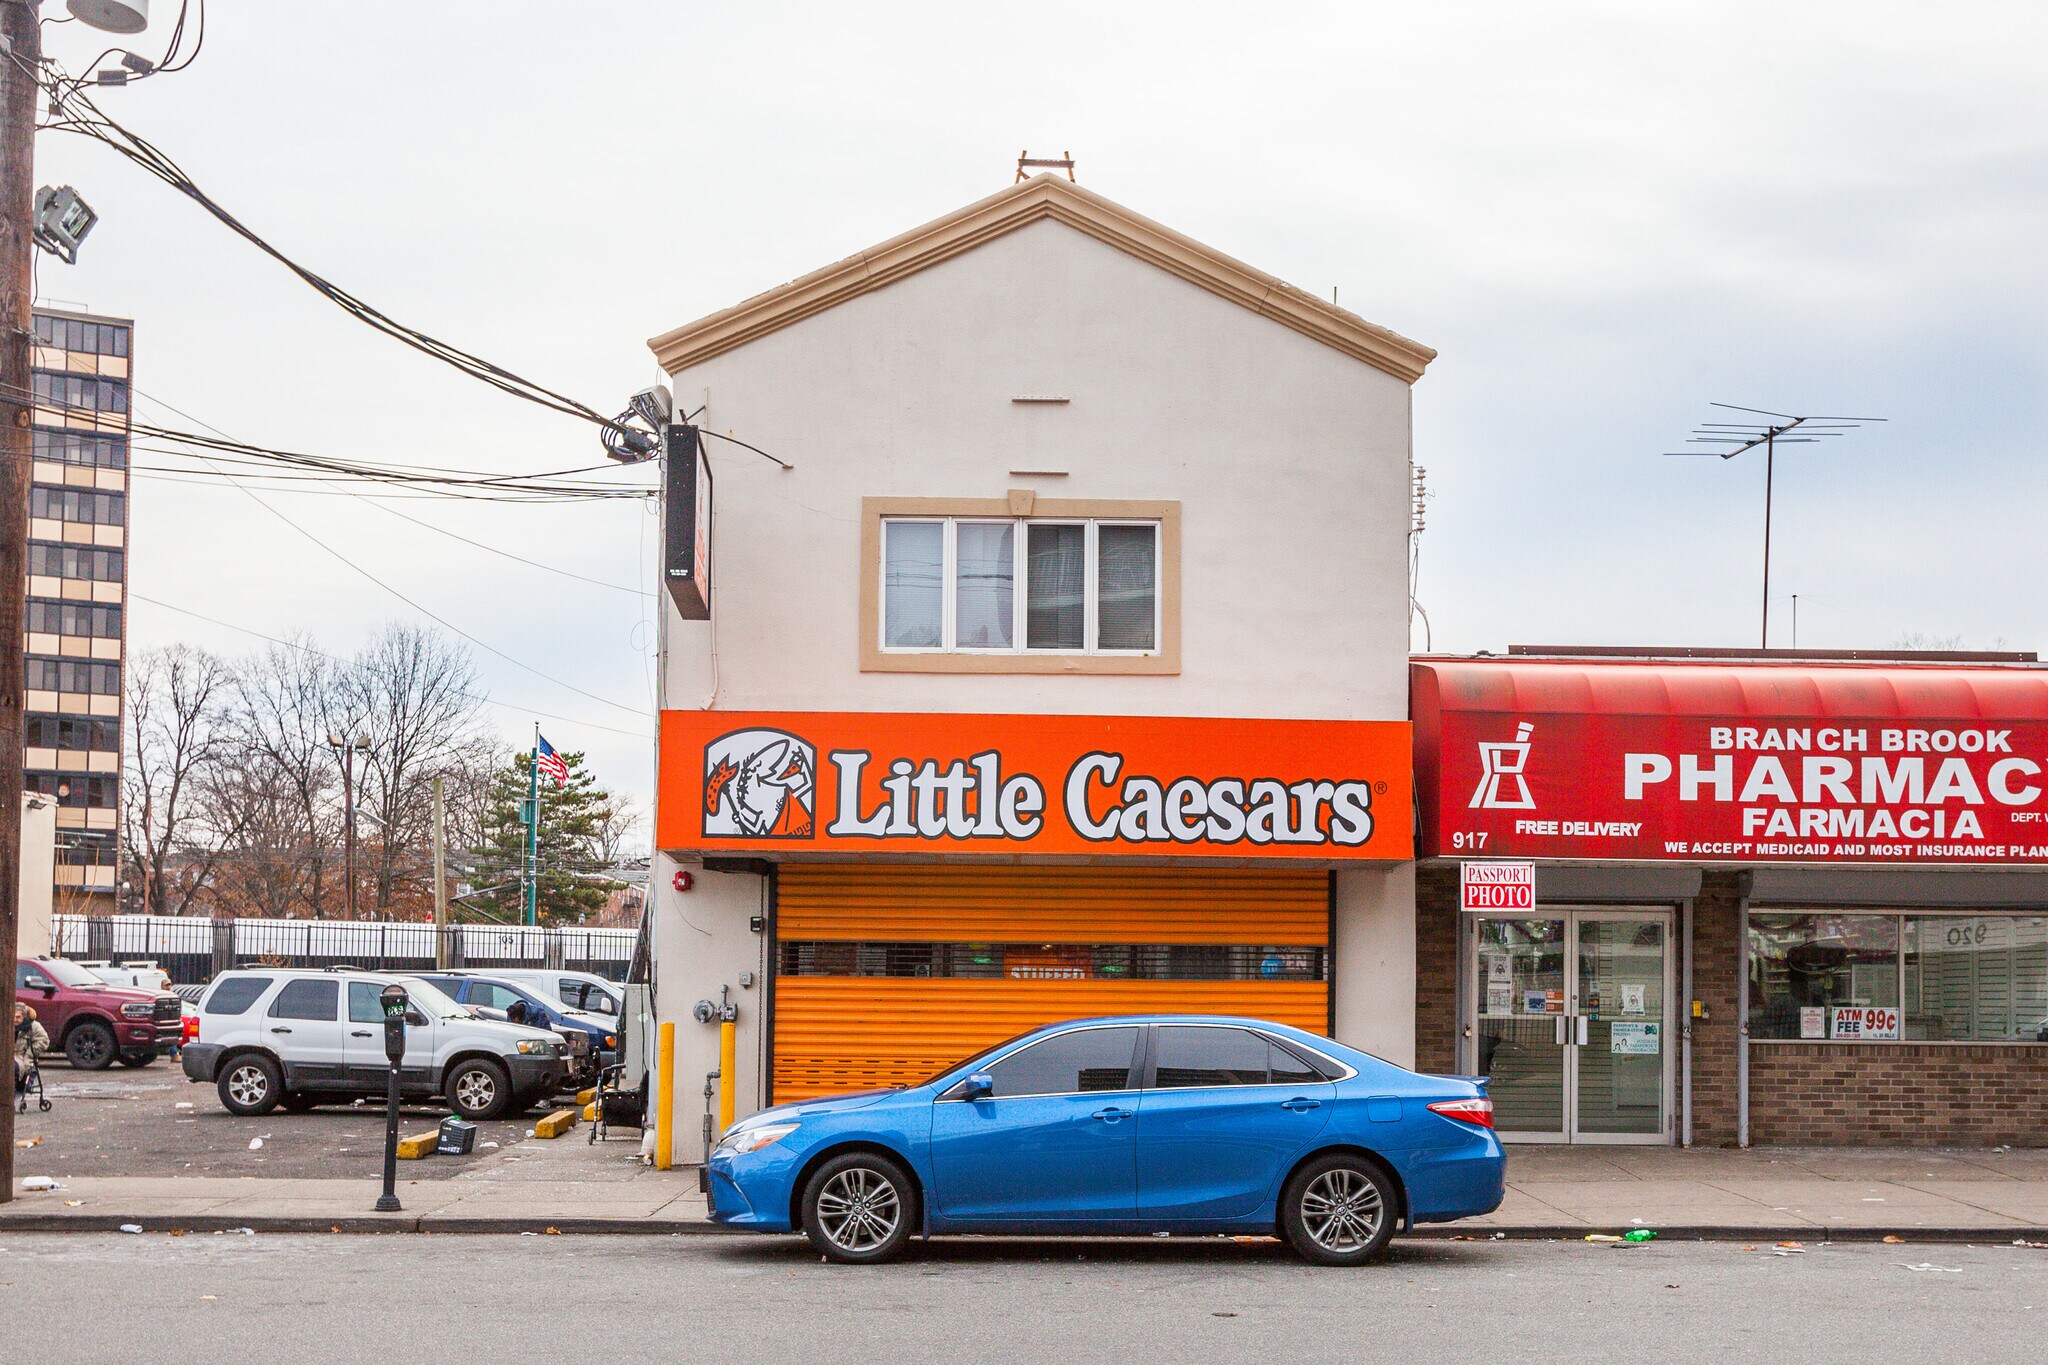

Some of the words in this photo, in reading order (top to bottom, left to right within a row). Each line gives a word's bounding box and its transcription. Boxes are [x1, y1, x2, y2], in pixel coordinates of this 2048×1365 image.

[1711, 727, 1868, 752] BRANCH
[1882, 728, 2013, 753] BROOK
[1624, 752, 2048, 806] PHARMAC
[827, 751, 1044, 840] Little
[1065, 753, 1372, 845] Caesars
[1743, 807, 1985, 840] FARMACIA
[2011, 812, 2042, 823] DEPT.
[1515, 820, 1559, 836] FREE
[1562, 821, 1643, 837] DELIVERY
[1453, 832, 1489, 849] 917
[1664, 841, 1688, 854] WE
[1691, 842, 1753, 854] ACCEPT
[1756, 843, 1830, 855] MEDICAID
[1833, 844, 1866, 856] AND
[1869, 844, 1913, 856] MOST
[1916, 844, 2006, 857] INSURANCE
[1468, 867, 1529, 882] PASSPORT
[1467, 885, 1530, 907] PHOTO
[1836, 1009, 1862, 1021] ATM
[1865, 1009, 1896, 1033] 99¢
[1837, 1021, 1860, 1033] FEE
